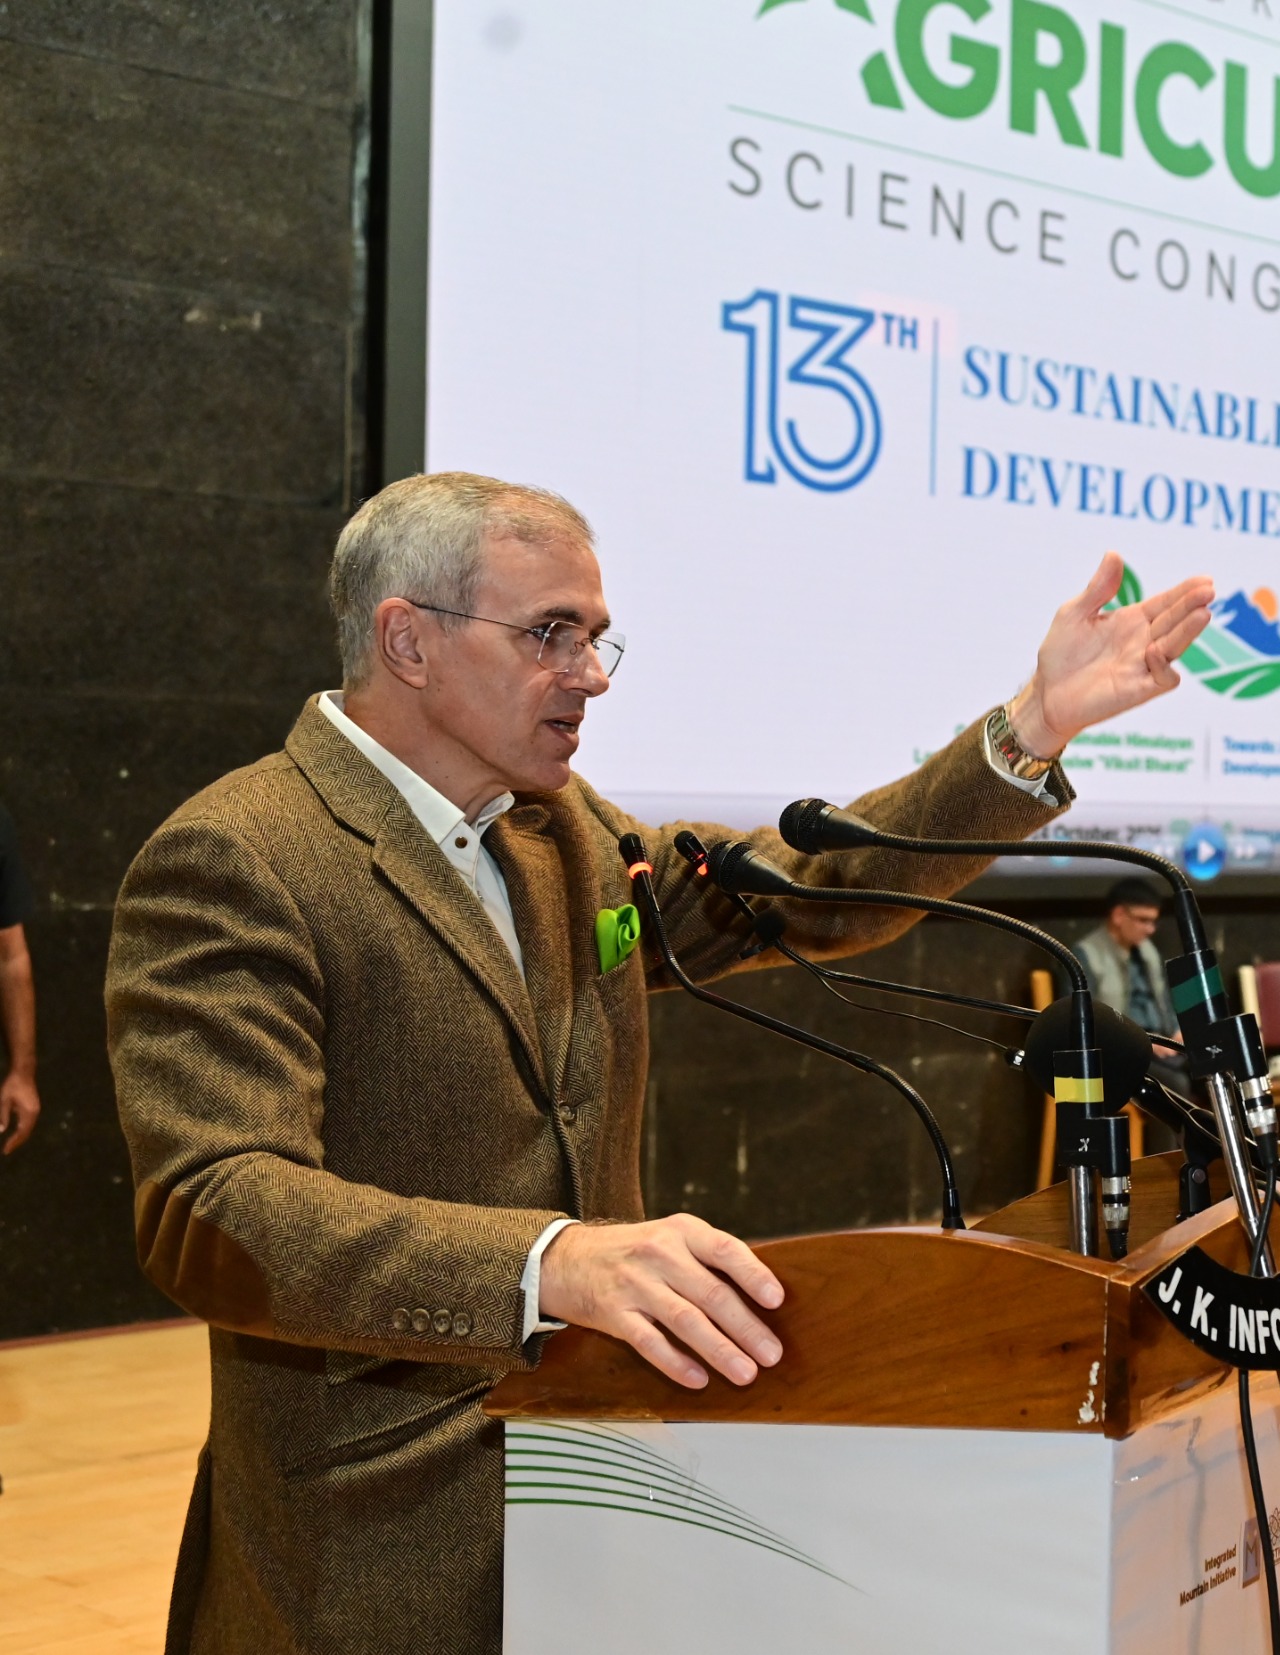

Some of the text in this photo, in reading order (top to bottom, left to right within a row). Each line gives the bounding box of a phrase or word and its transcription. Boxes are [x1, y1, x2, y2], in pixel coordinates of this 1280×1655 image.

[727, 135, 1068, 267] SCIENCE
[1158, 1267, 1183, 1315] J.
[1190, 1285, 1218, 1342] K.
[1179, 1565, 1236, 1607] Mountain Initiative
[1204, 1544, 1237, 1573] Integrated
